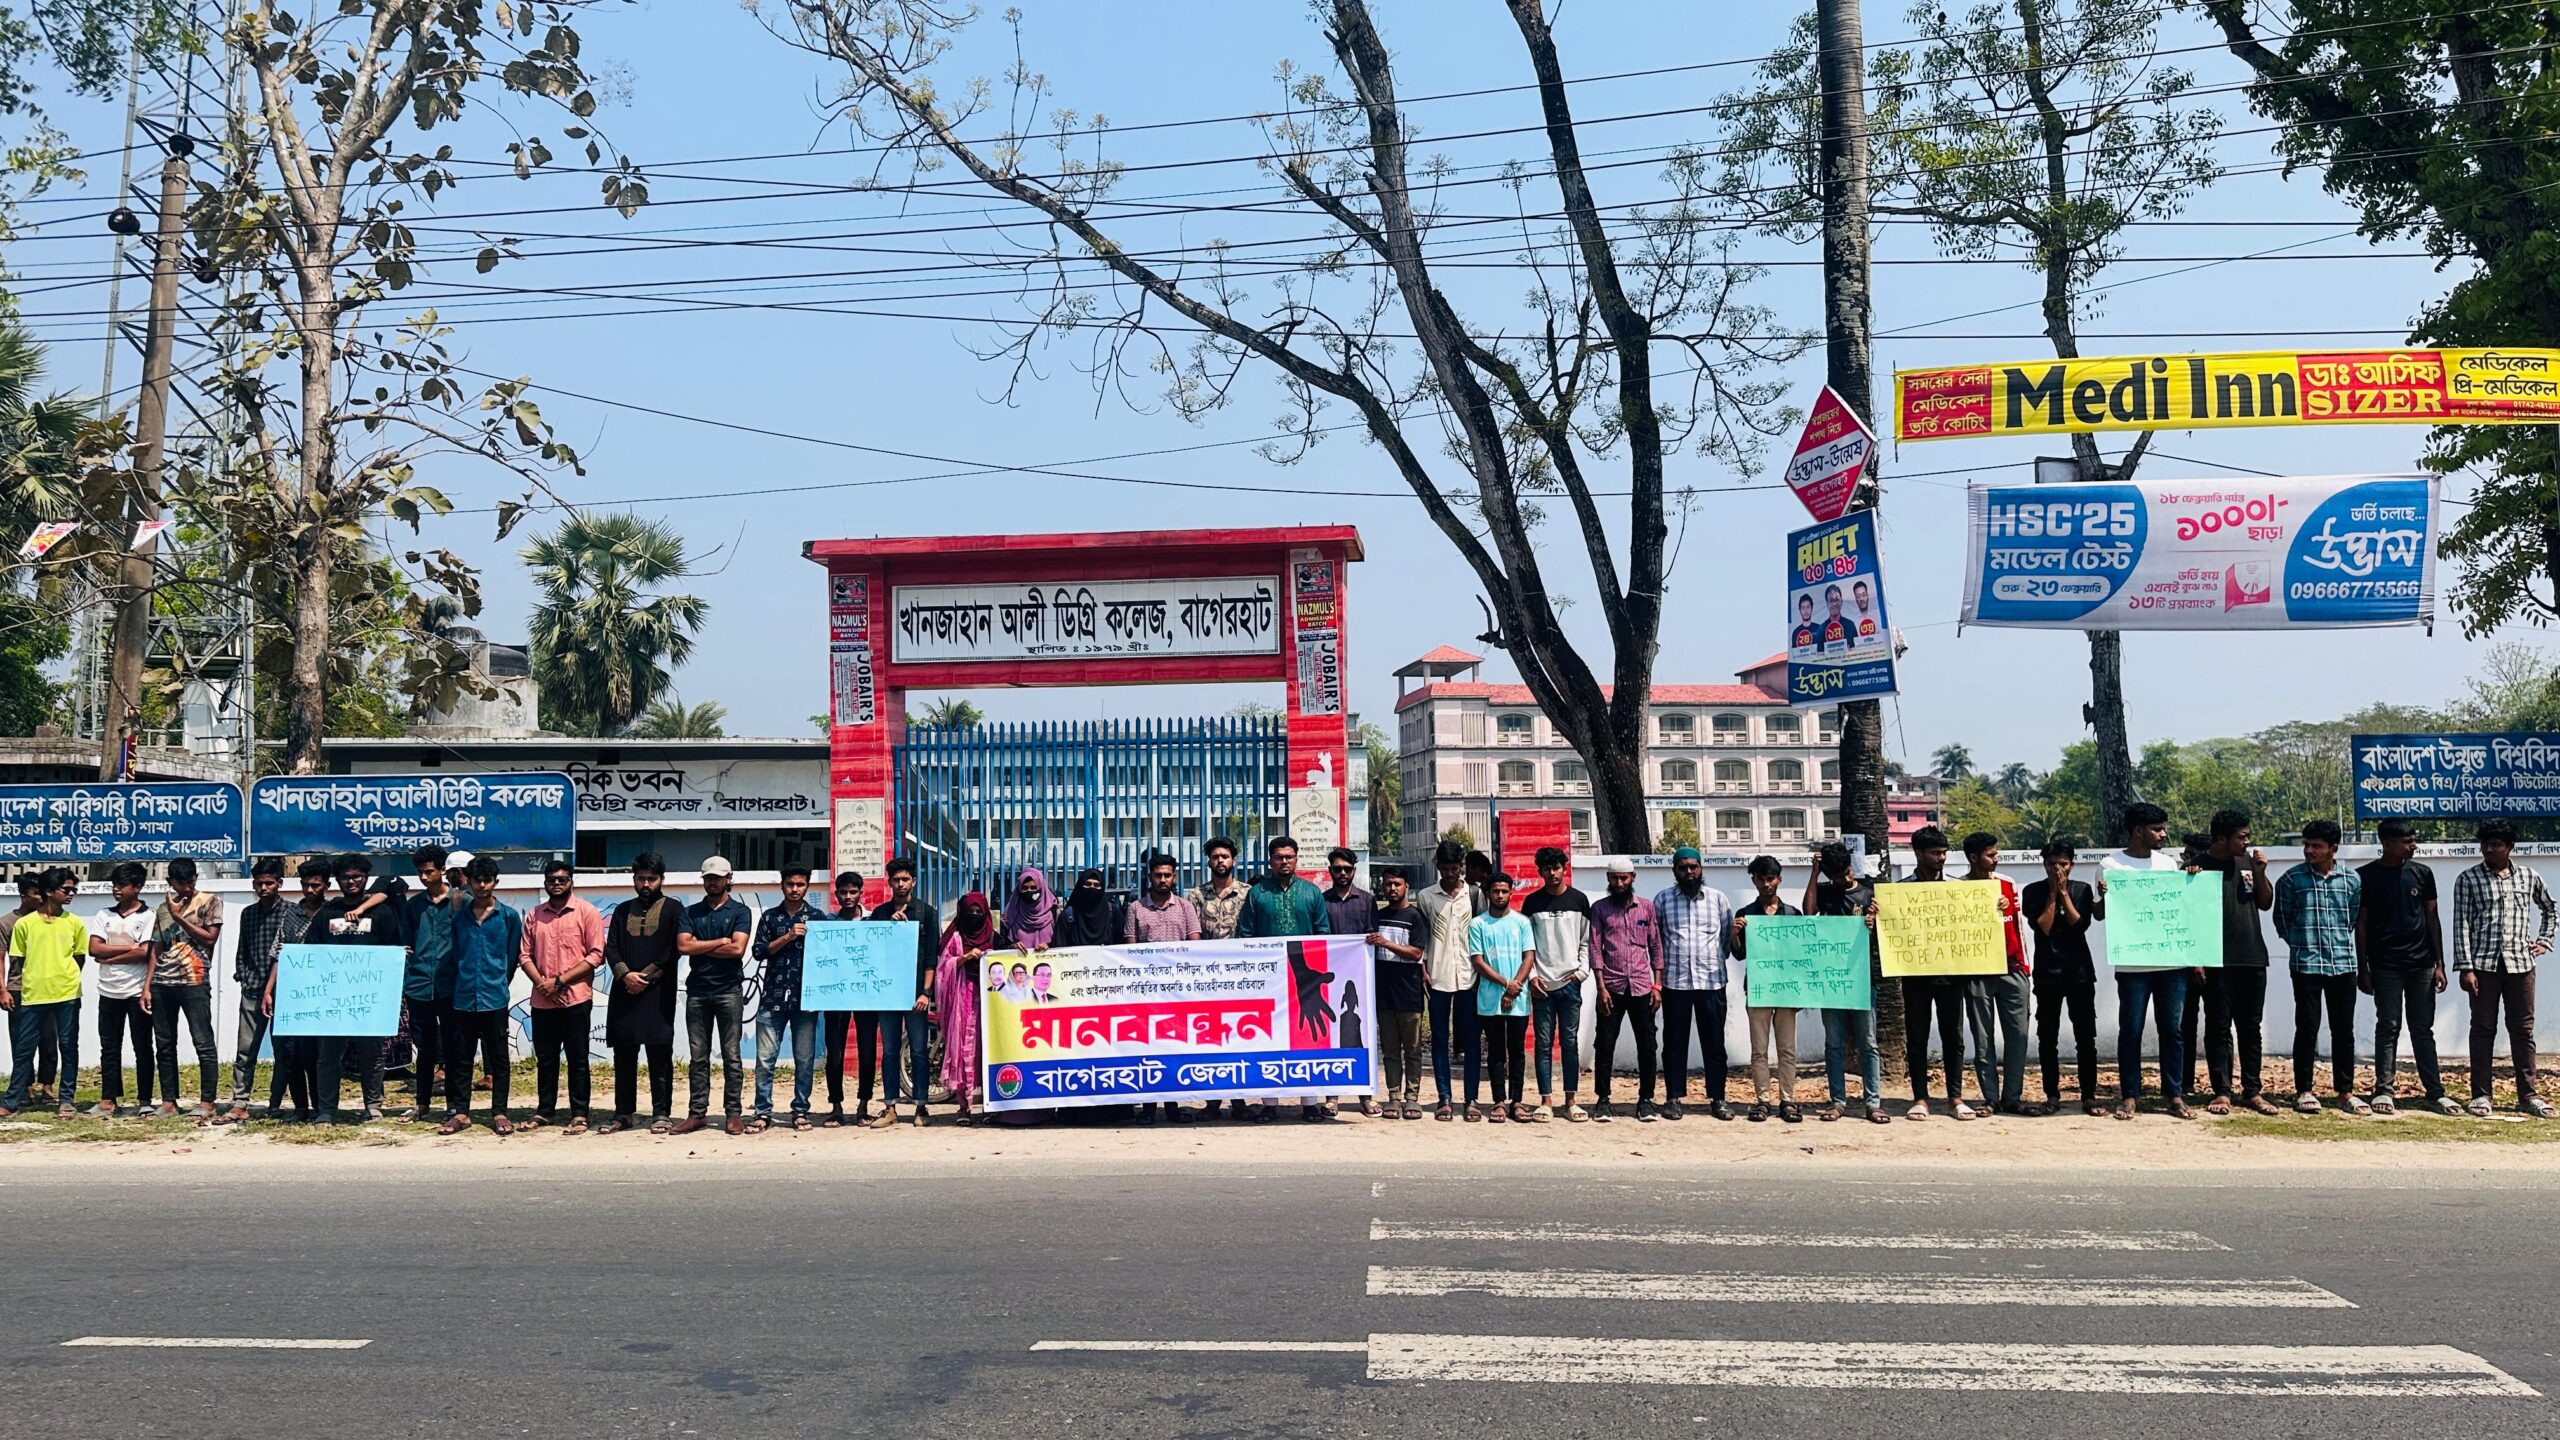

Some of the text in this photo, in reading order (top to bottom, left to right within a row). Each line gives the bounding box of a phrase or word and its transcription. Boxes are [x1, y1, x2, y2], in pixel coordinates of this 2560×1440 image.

[2302, 355, 2440, 388] ডাঃ আসিফ
[2460, 352, 2549, 373] মেডিকেল
[1909, 371, 1988, 391] সময়ের সেরা
[2453, 375, 2559, 398] প্রি-মেডিকেল
[1911, 392, 1984, 413] মেডিকেল
[2002, 357, 2297, 428] Medi Inn
[2308, 389, 2444, 416] SIZER
[1909, 415, 1986, 436] ভর্তি কোচিং
[2351, 502, 2378, 521] ভর্তি
[2247, 526, 2283, 542] ছাড়!
[1797, 523, 1859, 571] BUET
[1990, 542, 2133, 570] মডেল টেস্ট
[2302, 516, 2423, 577] উদ্ভাস
[2178, 568, 2198, 580] ভর্তি
[2026, 579, 2058, 597] ২৩
[2144, 581, 2179, 593] এখনই
[2290, 581, 2419, 599] 09666775566
[900, 583, 1274, 648] খানজাহান আলী ডিগ্রি কলেজ, বাগেরহাট
[1297, 601, 1335, 616] NAZMUL'S
[831, 614, 867, 627] NAZMUL'S
[1024, 644, 1067, 655] স্থাপিত
[857, 654, 873, 722] JOBAIR'S
[1321, 643, 1339, 712] JOBAIR'S
[1793, 666, 1845, 696] উদ্ভাস
[2360, 737, 2560, 773] বাংলাদেশ উন্মুক্ত বিশ্ববিদ
[619, 769, 686, 794] ভবন
[49, 787, 228, 818] কারিগরি শিক্ষা বোর্ড
[259, 783, 382, 813] খানজাহান
[488, 784, 566, 809] কলেজ
[578, 793, 628, 812] ডিগ্রি
[2363, 792, 2503, 814] খানজাহান আলী ডিগ্রি
[140, 822, 174, 835] শাখা
[36, 837, 72, 855] আলী
[76, 837, 106, 855] ডিগ্রি
[1885, 888, 1991, 906] I WILL NEVER
[1963, 903, 1991, 915] WHY
[1881, 913, 1997, 931] IT IS MORE SHAMEFUL
[813, 926, 893, 944] আমার সোনার
[1887, 927, 1993, 949] TO BE RAPED THAN
[287, 951, 374, 968] WE WANT
[1893, 942, 1990, 965] TO BE A RAPIST
[320, 970, 384, 984] WE WANT
[1060, 966, 1090, 980] দেশব্যাপী
[1091, 965, 1117, 979] নারীদের
[1119, 964, 1141, 977] বিরুদ্ধে
[1224, 960, 1255, 973] অনলাইনে
[1070, 986, 1084, 997] এবং
[1126, 980, 1158, 996] পরিস্থিতির
[1159, 979, 1183, 993] অবনতি
[1186, 984, 1192, 992] ও
[1193, 977, 1235, 992] বিচারহীনতার
[1237, 977, 1265, 990] প্রতিবাদে
[331, 992, 378, 1008] JUSTICE
[1020, 998, 1276, 1050] মানববন্ধন
[1033, 1060, 1167, 1093] বাগেরহাট
[1177, 1058, 1251, 1086] জেলা
[1257, 1057, 1356, 1087] ছাত্রদল
